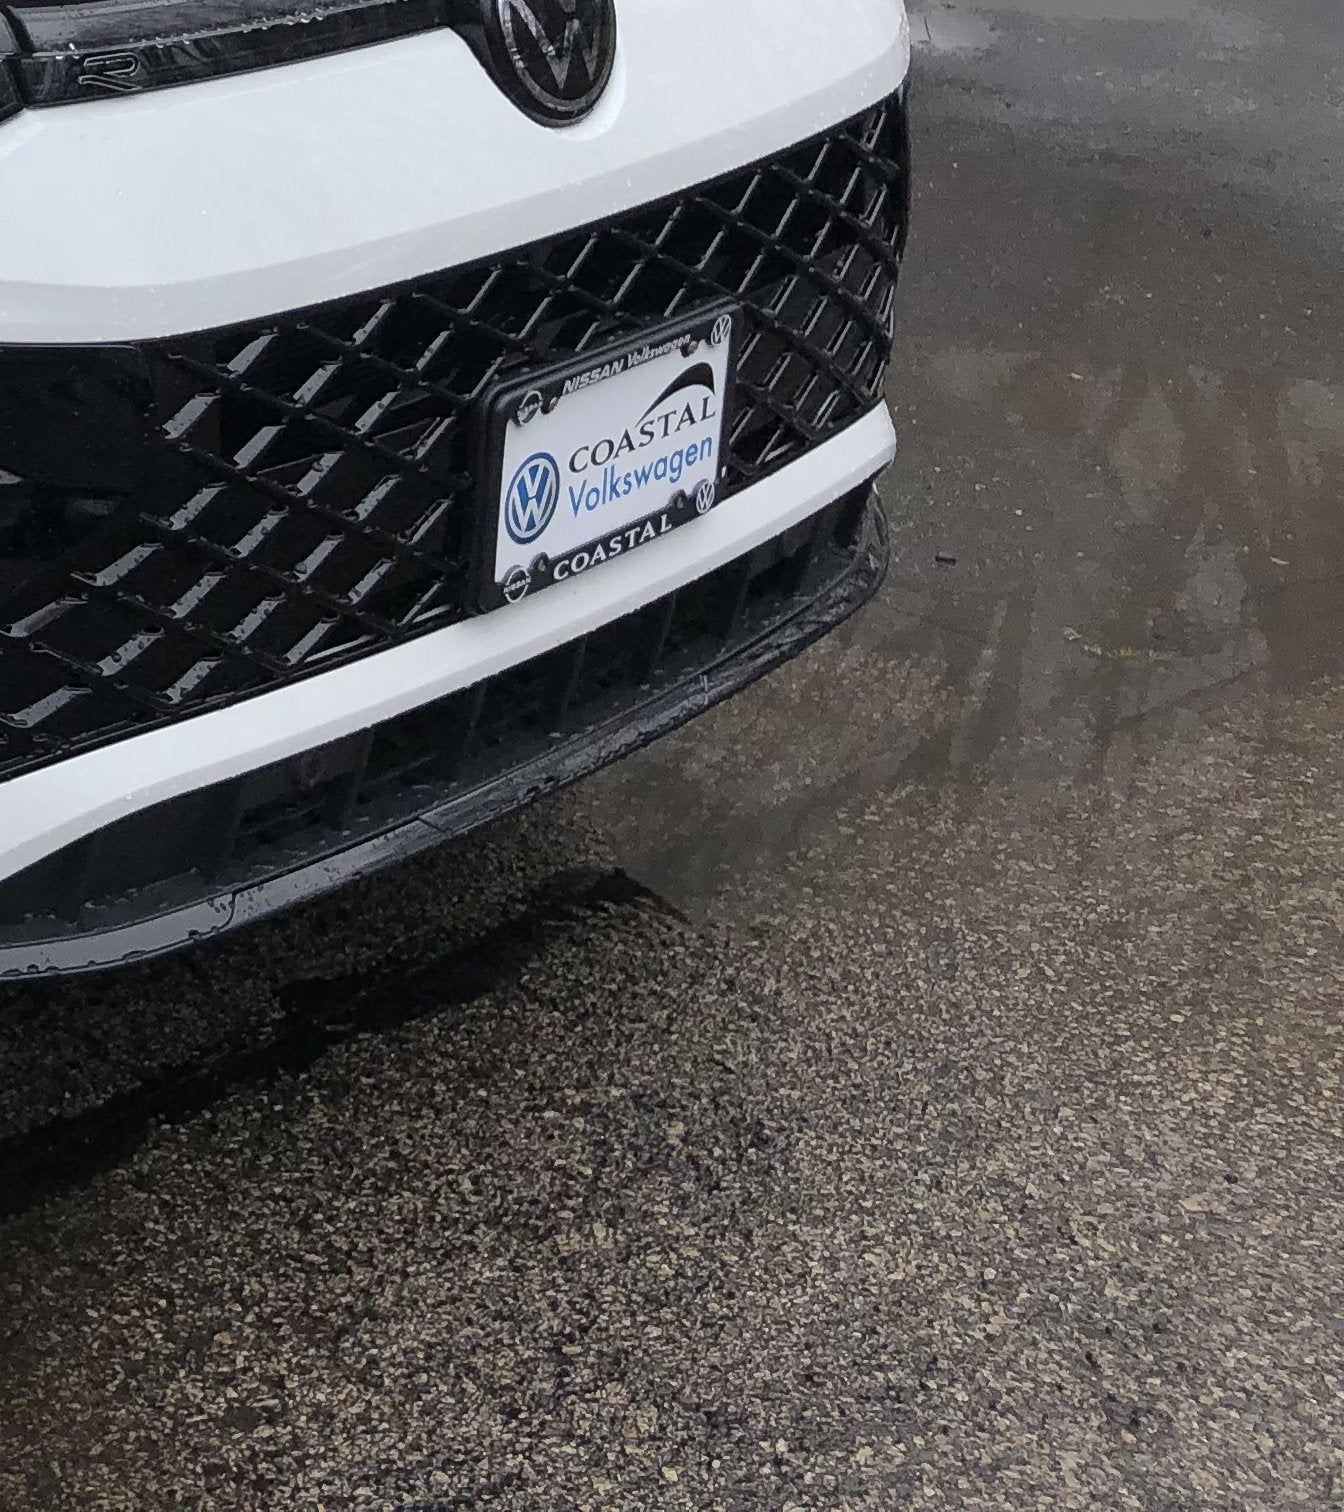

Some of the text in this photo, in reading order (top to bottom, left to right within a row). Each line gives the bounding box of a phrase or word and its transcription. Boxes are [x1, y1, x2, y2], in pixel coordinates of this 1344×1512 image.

[562, 359, 624, 395] NISSAN
[568, 396, 716, 473] COASTAL
[506, 454, 559, 542] VW
[568, 436, 713, 518] Volkswagen
[553, 513, 673, 580] COASTAL
